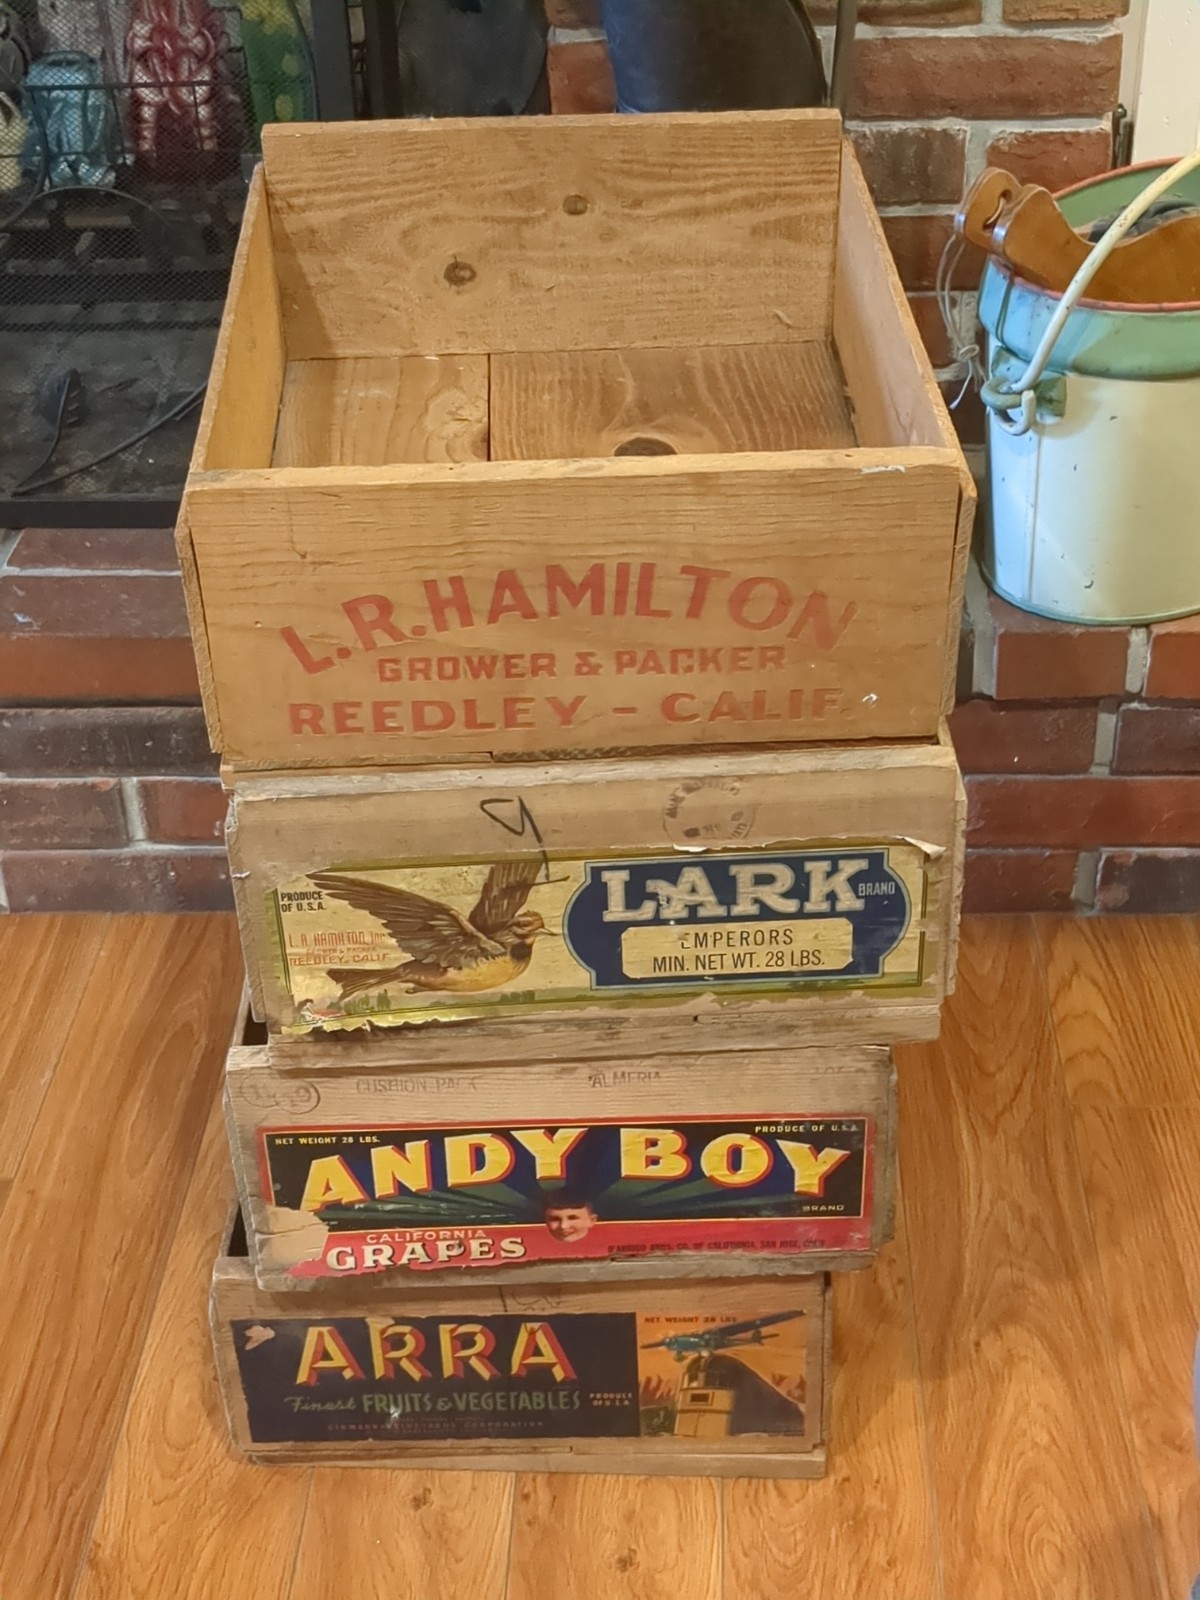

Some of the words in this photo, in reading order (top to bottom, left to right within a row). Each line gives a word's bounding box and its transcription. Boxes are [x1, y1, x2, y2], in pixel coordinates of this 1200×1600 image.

[377, 653, 557, 683] GROWER
[573, 651, 602, 677] &
[614, 646, 787, 676] PACKER
[289, 695, 588, 736] REEDLEY
[281, 891, 324, 902] PRODUCE
[601, 858, 870, 923] LARK
[858, 881, 896, 897] BRAND
[281, 903, 293, 913] OF
[653, 954, 690, 973] MIN.
[695, 953, 727, 970] NET
[731, 951, 761, 969] WT.
[765, 951, 785, 967] 28
[790, 949, 825, 967] LBS.
[755, 1125, 805, 1134] PRODUCE
[811, 1124, 825, 1132] OF
[275, 1137, 293, 1146] NET
[298, 1136, 337, 1145] WEIGHT
[342, 1136, 354, 1144] 28
[359, 1135, 381, 1144] LBS.
[300, 1128, 589, 1213] ANDY
[620, 1128, 851, 1198] BOY
[803, 1204, 845, 1212] BRAND
[366, 1230, 487, 1244] CALIFORNIA
[326, 1237, 527, 1272] GRAPES
[644, 1316, 661, 1324] NET
[665, 1316, 700, 1324] WEIGHT
[296, 1321, 578, 1387] ARRA
[284, 1396, 357, 1413] Finest
[362, 1393, 432, 1413] FRUITS
[436, 1398, 452, 1411] &
[453, 1391, 580, 1412] VEGETABLES
